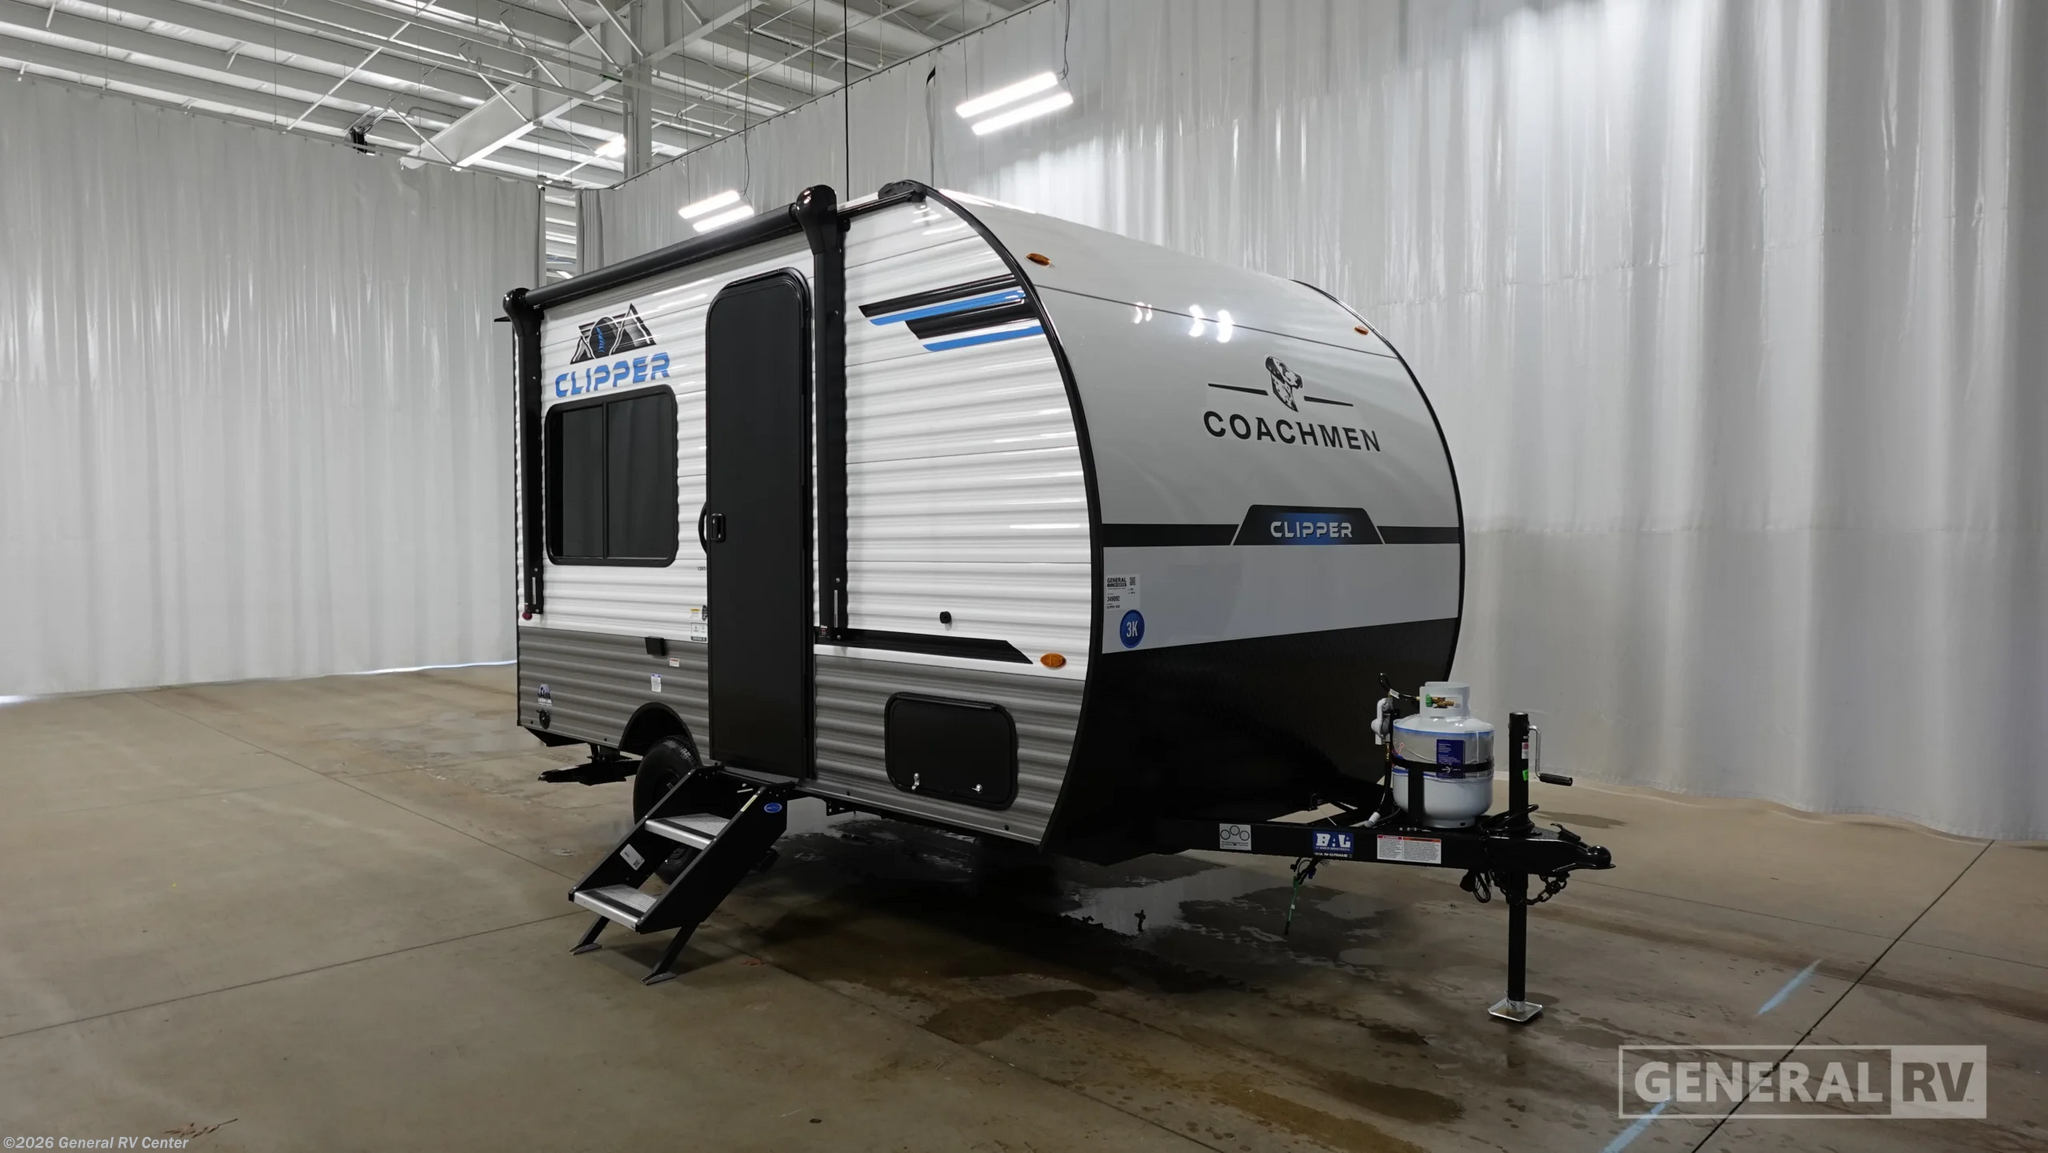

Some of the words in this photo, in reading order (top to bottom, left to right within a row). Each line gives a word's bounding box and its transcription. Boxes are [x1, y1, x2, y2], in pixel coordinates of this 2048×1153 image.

[555, 352, 671, 398] CLIPPER
[1203, 411, 1381, 452] COACHMEN
[1270, 521, 1353, 538] CLIPPER
[1126, 620, 1139, 638] 3K
